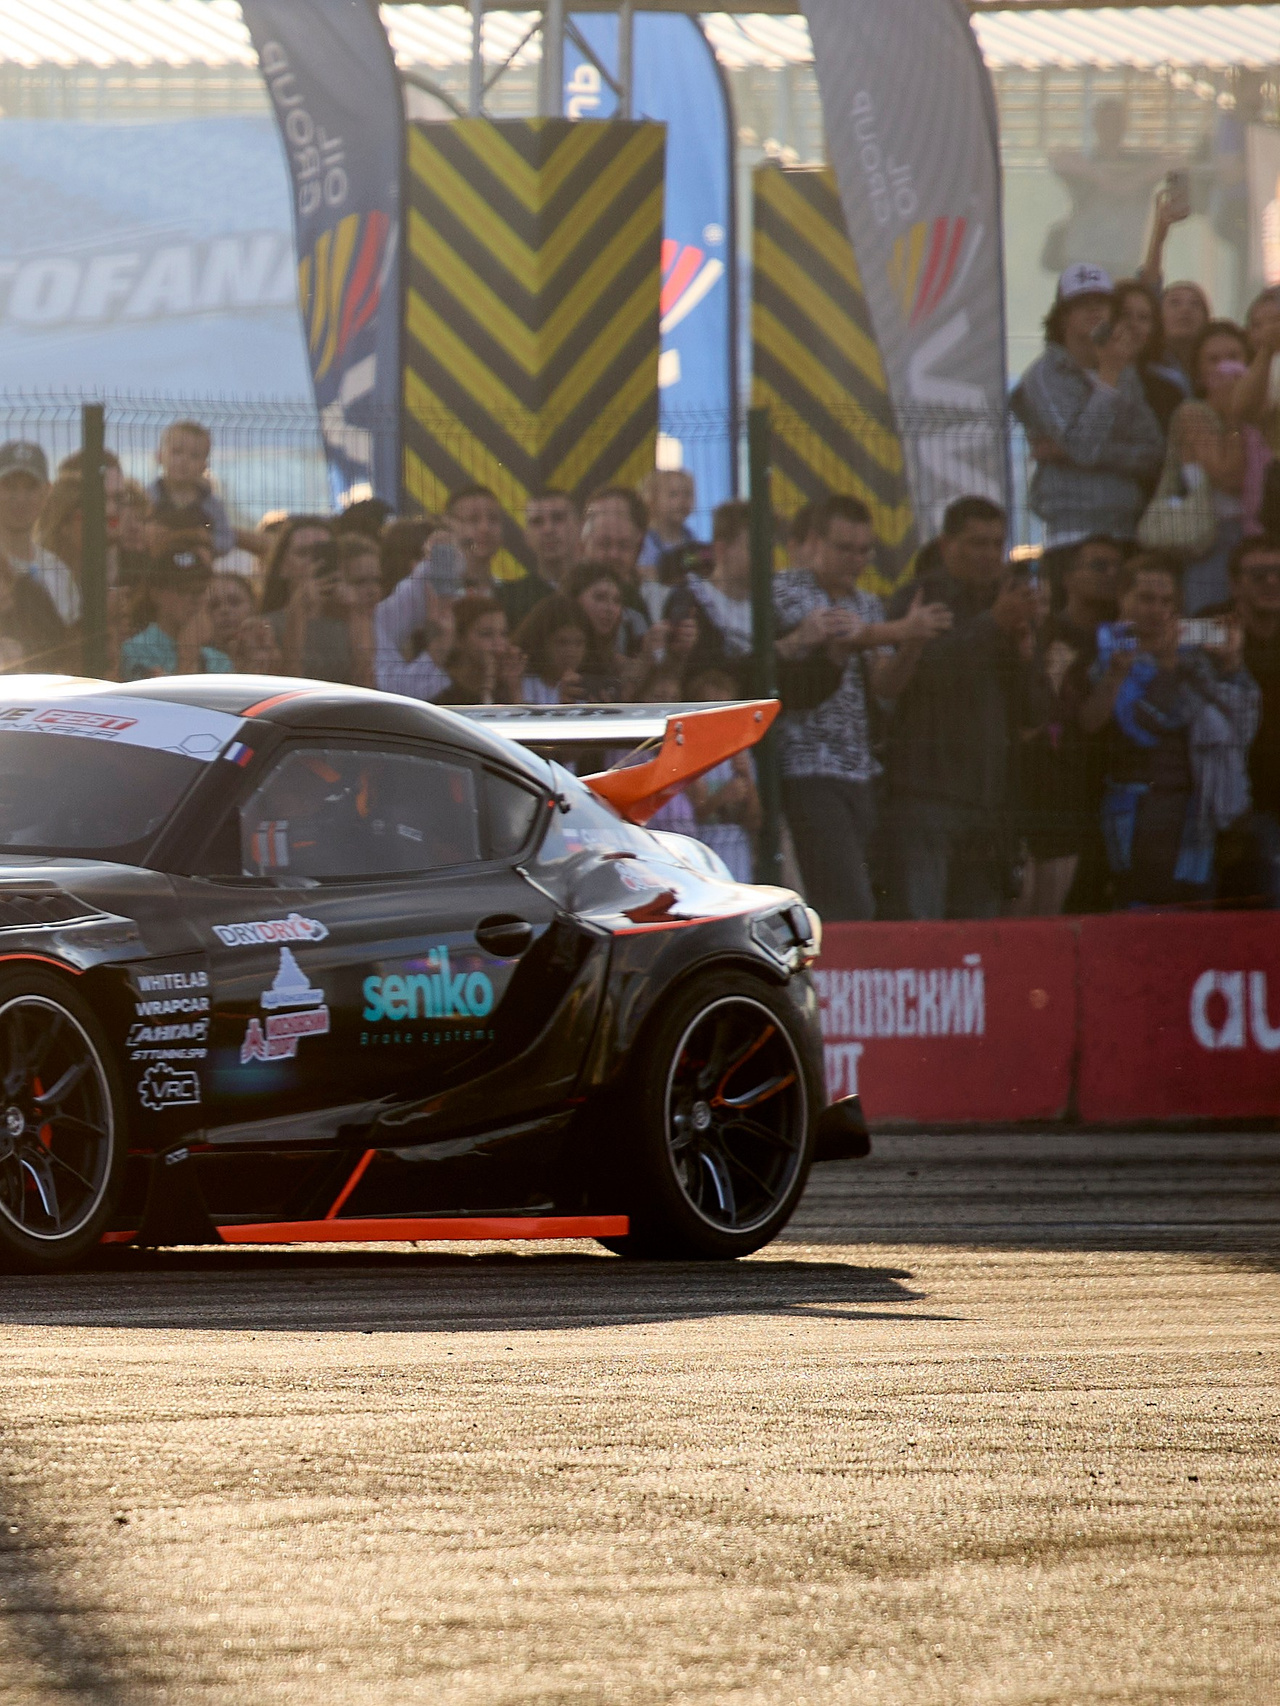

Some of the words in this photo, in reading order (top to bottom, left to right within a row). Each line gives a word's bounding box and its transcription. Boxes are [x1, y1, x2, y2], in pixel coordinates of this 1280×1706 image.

[137, 971, 208, 991] WHITELAB
[363, 945, 494, 1022] seniko
[135, 997, 210, 1016] WRAPCAR
[360, 1031, 413, 1045] Brake
[422, 1029, 495, 1044] systems
